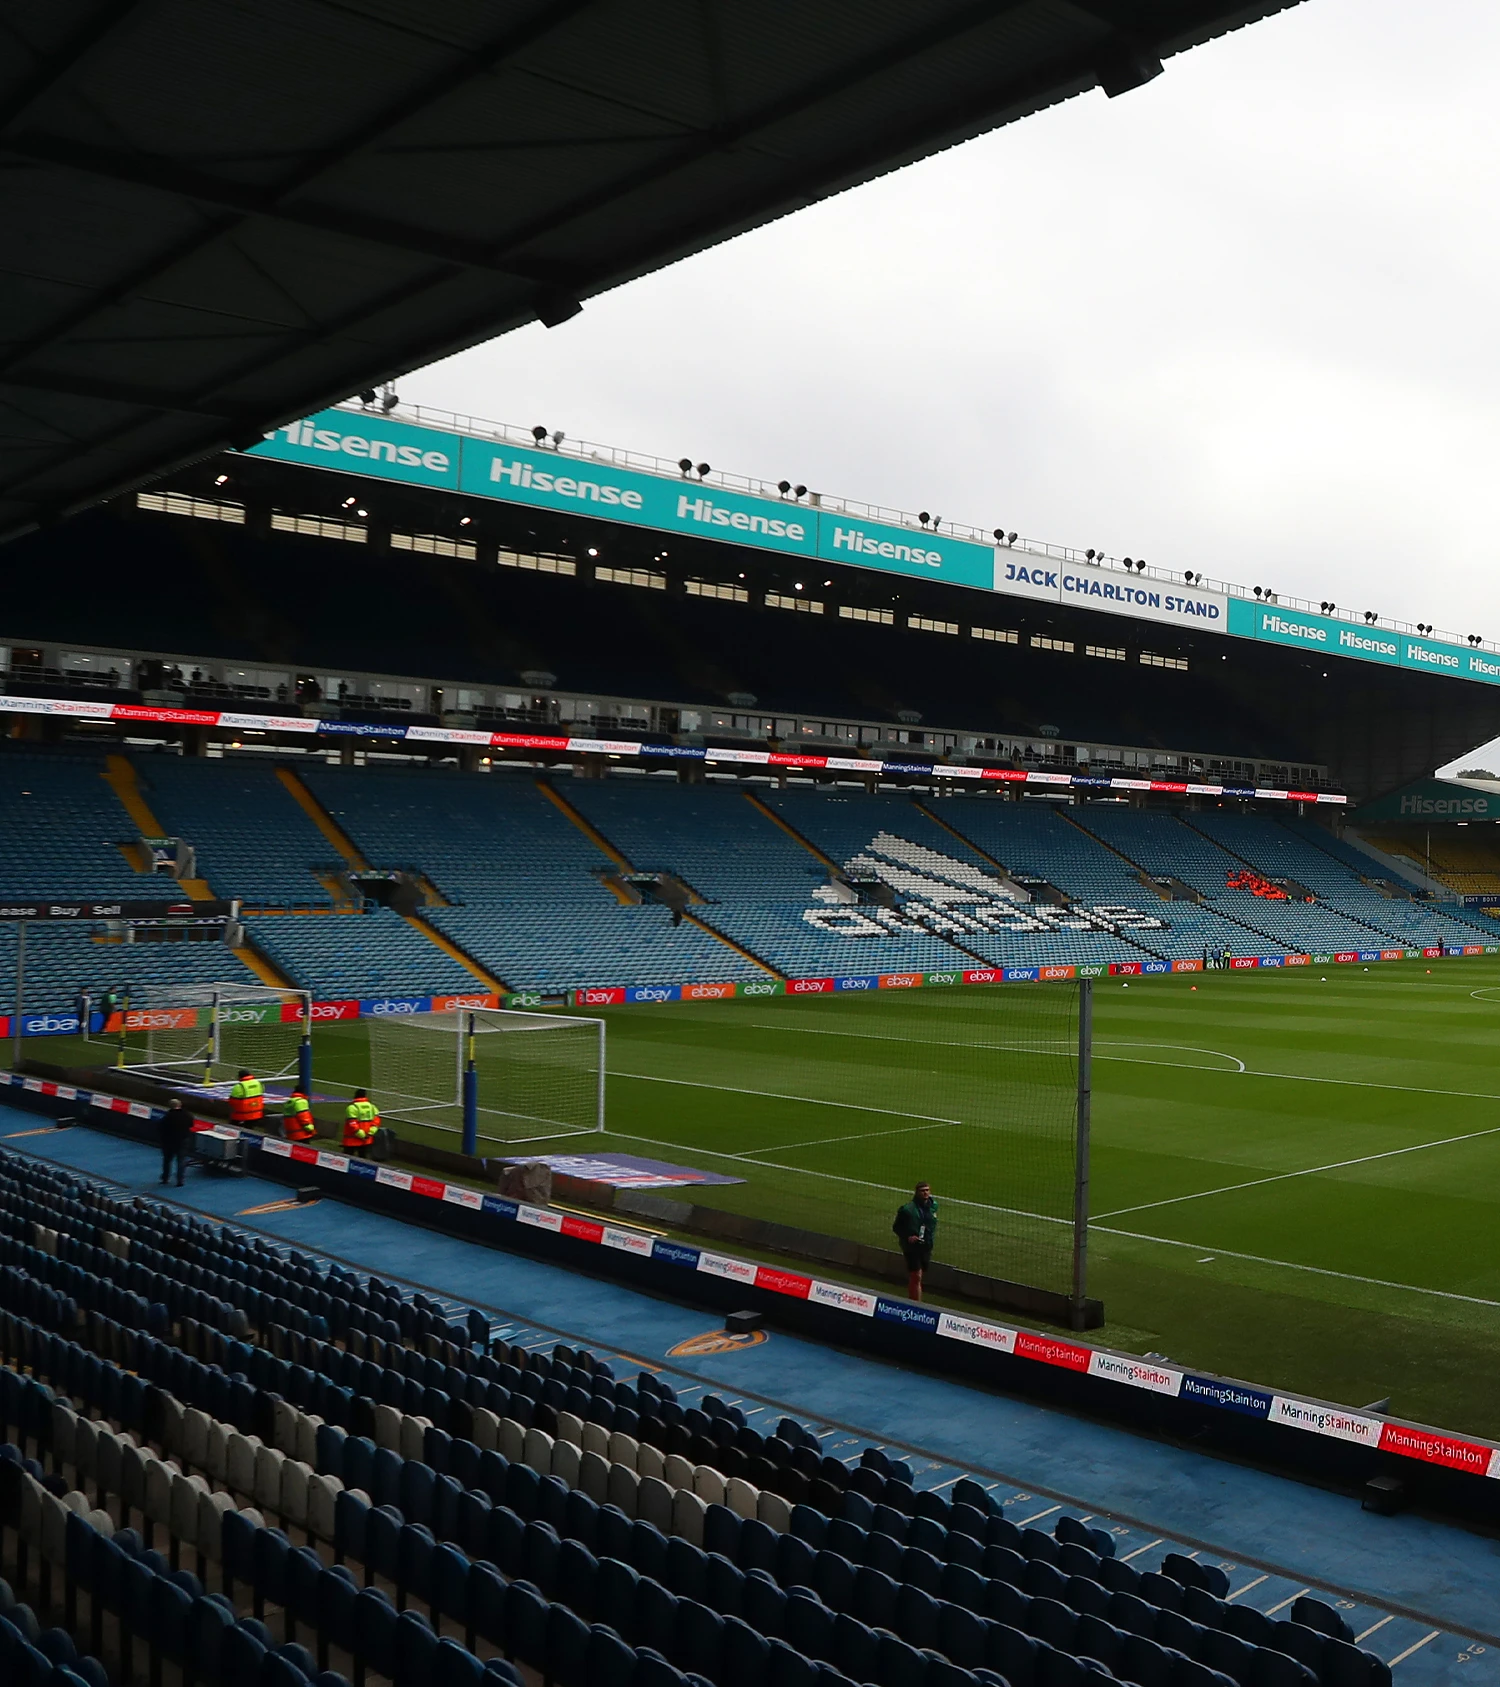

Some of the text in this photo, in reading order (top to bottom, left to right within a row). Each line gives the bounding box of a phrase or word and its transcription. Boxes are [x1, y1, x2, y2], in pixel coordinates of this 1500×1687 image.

[489, 456, 642, 511] Hisense
[676, 494, 804, 541] Hisense
[833, 527, 942, 568] Hisense
[1004, 563, 1220, 620] JACK CHARLTON STAND
[1262, 614, 1327, 642] Hisense
[1339, 630, 1397, 655] Hisense
[1407, 644, 1459, 668] Hisense
[114, 707, 215, 721] ManningStainton
[222, 716, 315, 730] ManningStainton
[319, 721, 405, 736] ManningStainton
[410, 728, 488, 742] ManningStainton
[492, 735, 566, 748] ManningStainton
[570, 740, 638, 752] ManningStainton
[641, 745, 705, 757] ManningStainton
[708, 749, 768, 762] ManningStainton
[769, 754, 825, 766] ManningStainton
[828, 759, 880, 769] ManningStainton
[882, 763, 932, 774] ManningStainton
[934, 766, 980, 776] ManningStainton
[983, 770, 1026, 780] ManningStainton
[1028, 773, 1070, 782] ManningStainton
[1400, 795, 1489, 815] Hisense
[0, 905, 122, 918] ease Buy Sell
[635, 986, 672, 1002] ebay
[691, 984, 727, 999] ebay
[744, 982, 776, 997] ebay
[793, 979, 825, 994] ebay
[842, 977, 871, 991] ebay
[887, 974, 914, 988] ebay
[929, 972, 956, 985] ebay
[970, 970, 995, 983] ebay
[1008, 968, 1034, 981] ebay
[1045, 967, 1069, 979] ebay
[1080, 965, 1103, 978] ebay
[1145, 962, 1168, 974] ebay
[1176, 960, 1198, 972] ebay
[1235, 958, 1255, 969] ebay
[1262, 956, 1282, 968] ebay
[1288, 955, 1307, 967] ebay
[1313, 953, 1332, 965] ebay
[1337, 952, 1356, 963] ebay
[1361, 951, 1378, 961] ebay
[1384, 950, 1400, 960] ebay
[1405, 949, 1420, 958] ebay
[1427, 948, 1440, 958] ebay
[1466, 946, 1480, 955] ebay
[1485, 945, 1498, 953] ebay
[27, 1015, 81, 1032] eba
[126, 996, 490, 1028] ebay ebay ebay ebay ebay
[653, 1242, 698, 1264] ManningStainton
[704, 1255, 751, 1278] ManningStainton
[757, 1267, 808, 1293] ManningStainton
[815, 1283, 868, 1308] ManningStainton
[877, 1300, 936, 1327] ManningStainton
[945, 1318, 1008, 1345] ManningStainton
[1018, 1336, 1085, 1365] ManningStainton
[1096, 1357, 1171, 1388] ManningStainton
[1185, 1378, 1266, 1411] ManningStainton
[1280, 1401, 1369, 1436] ManningStainton
[1385, 1427, 1483, 1466] ManningStainton
